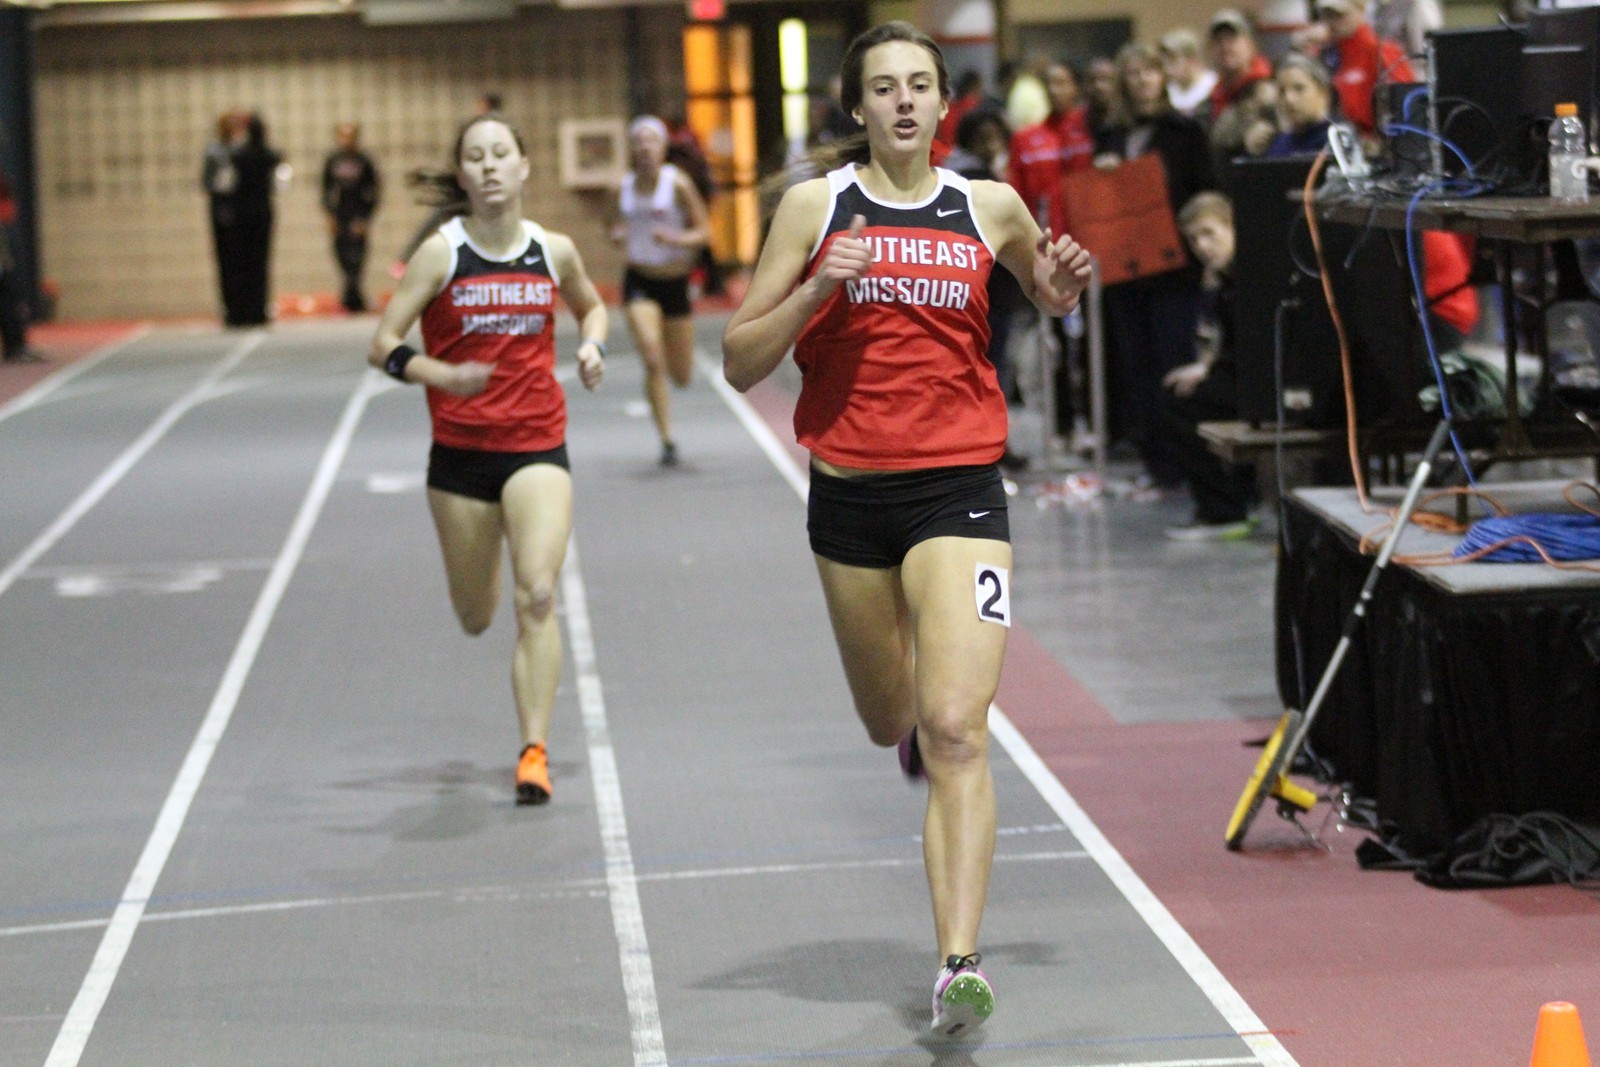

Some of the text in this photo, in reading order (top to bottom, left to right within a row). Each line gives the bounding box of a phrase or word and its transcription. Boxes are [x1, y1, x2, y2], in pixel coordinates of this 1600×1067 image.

[857, 236, 978, 271] UTHEAST
[451, 282, 553, 307] SOUTHEAST
[846, 277, 970, 310] MISSOURI
[978, 569, 1005, 621] 2
